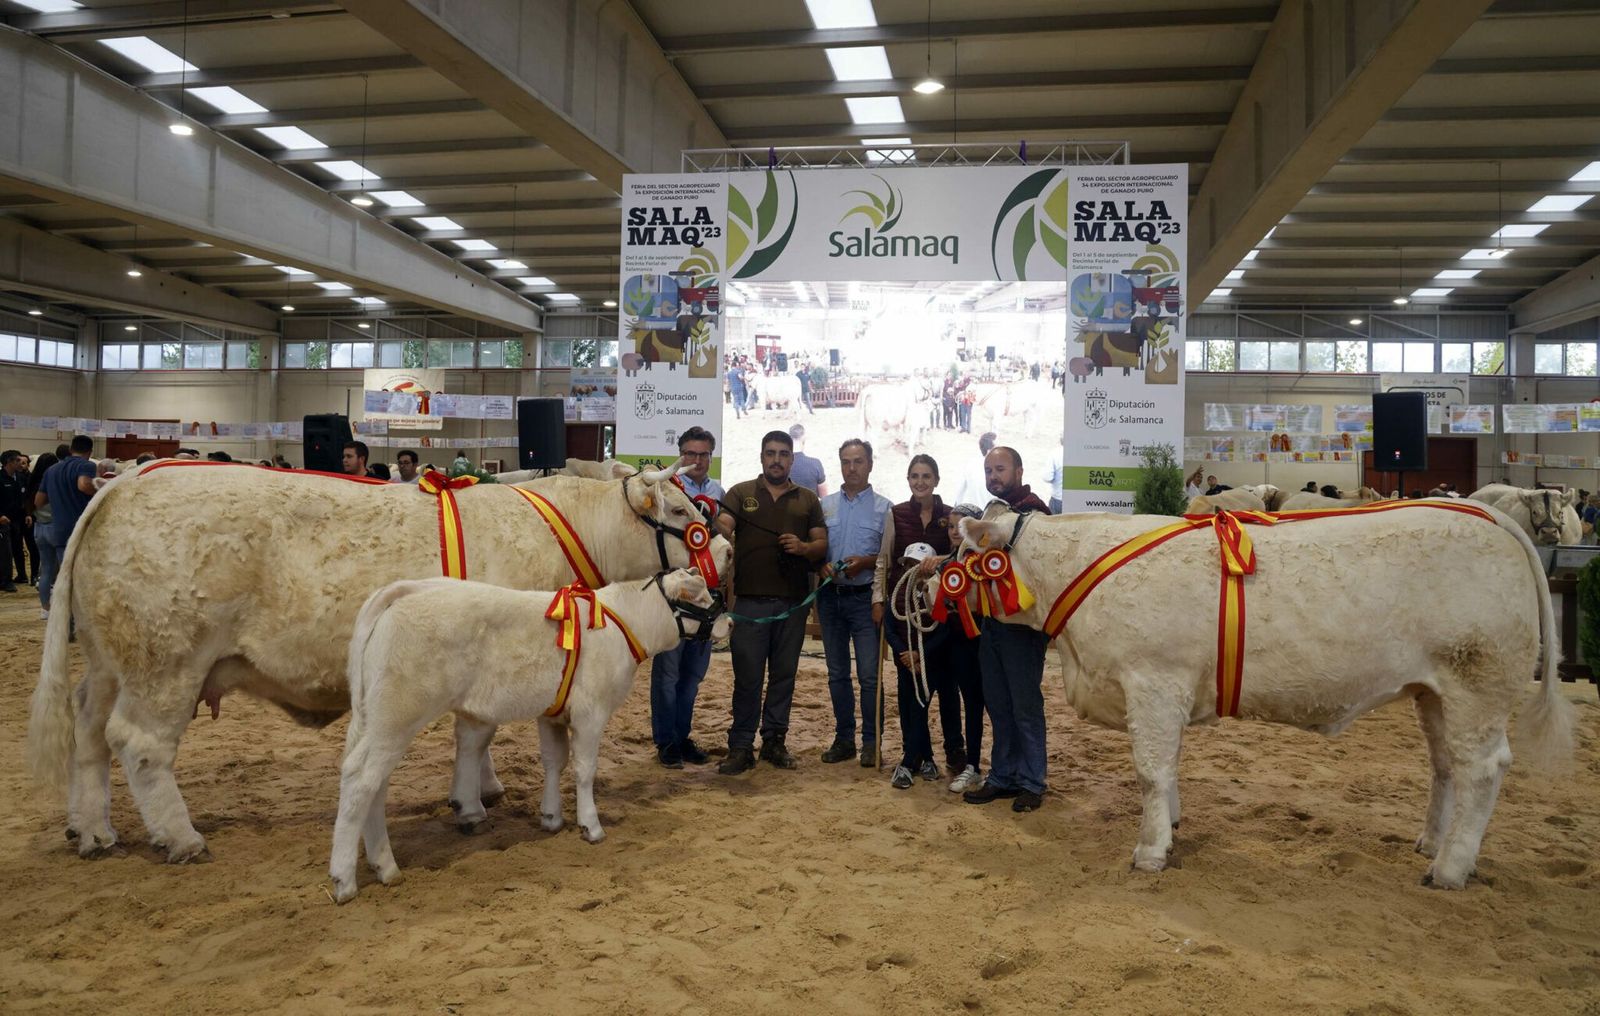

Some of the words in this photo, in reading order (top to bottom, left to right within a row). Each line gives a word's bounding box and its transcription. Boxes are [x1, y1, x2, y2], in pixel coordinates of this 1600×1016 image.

[1074, 200, 1172, 221] SALA
[627, 206, 714, 226] SALA
[828, 227, 959, 264] Salamaq
[656, 392, 697, 401] Diputación
[1437, 391, 1447, 399] DE
[1109, 399, 1155, 409] Diputación
[665, 406, 705, 416] Salamanca
[1108, 416, 1116, 424] de
[1119, 415, 1164, 425] Salamanca
[1089, 470, 1115, 478] SALA
[1089, 478, 1113, 487] MAQ
[1086, 500, 1136, 508] www.salam
